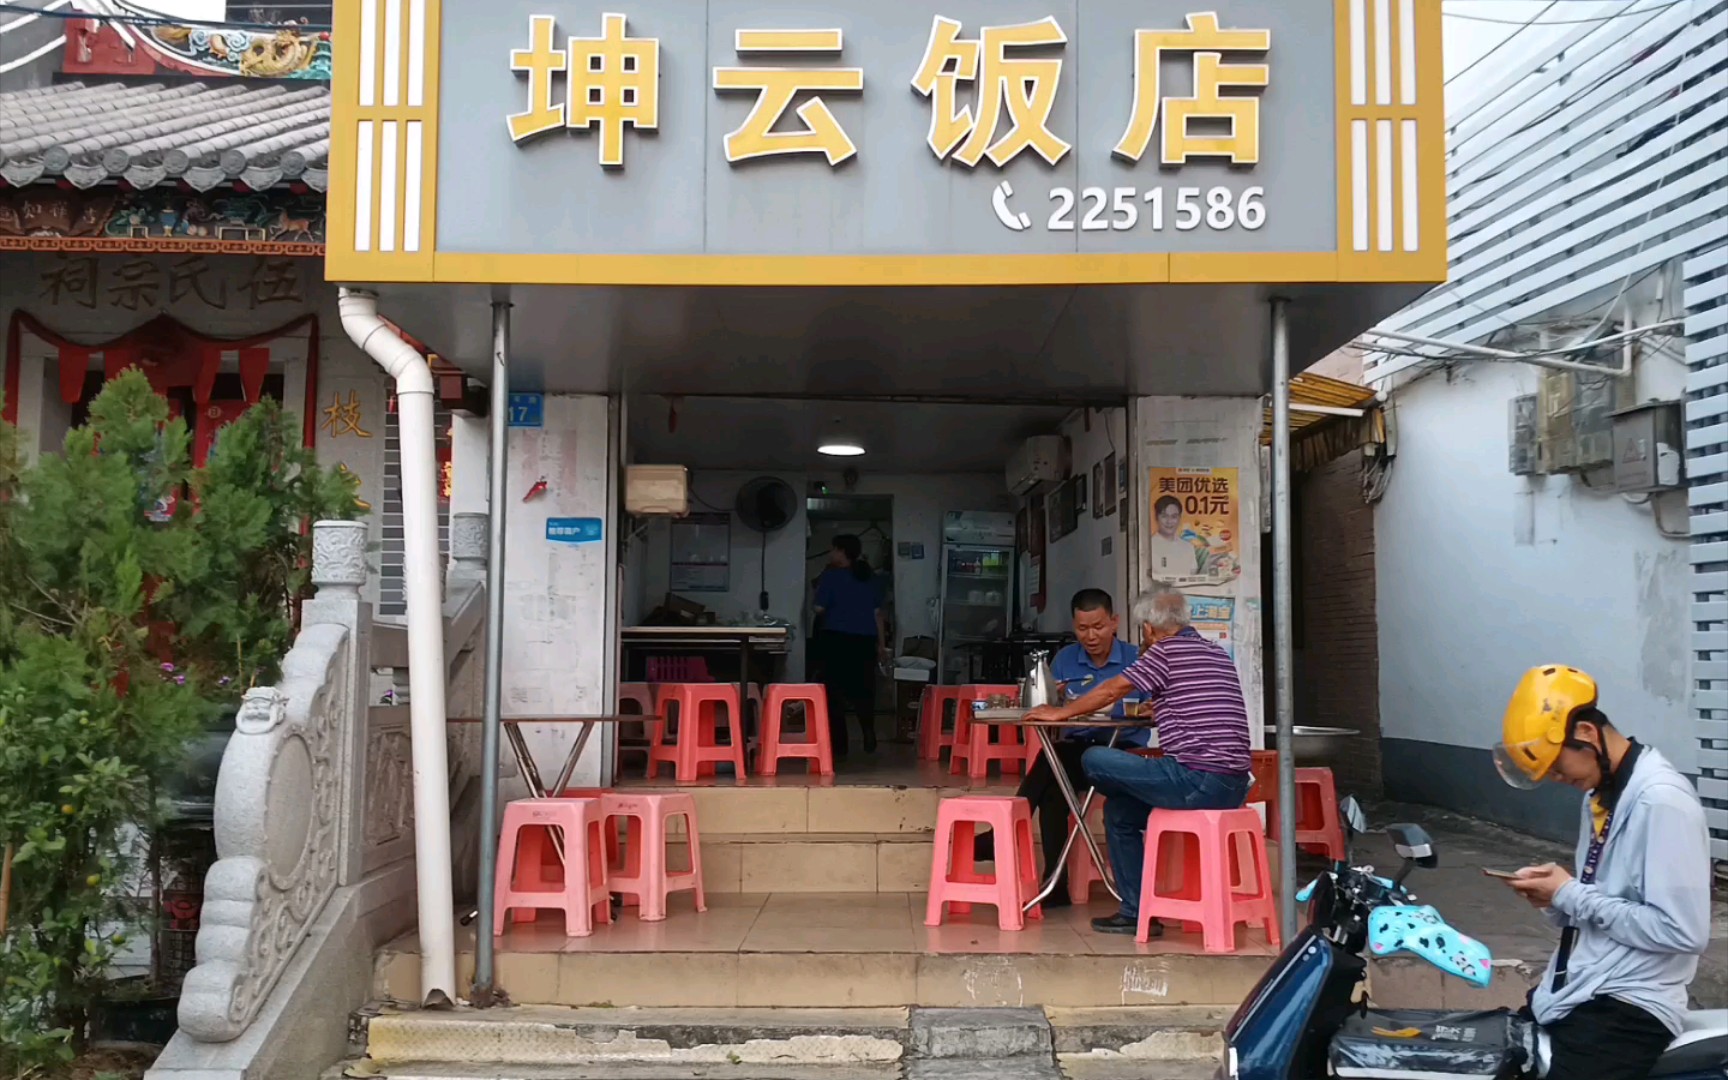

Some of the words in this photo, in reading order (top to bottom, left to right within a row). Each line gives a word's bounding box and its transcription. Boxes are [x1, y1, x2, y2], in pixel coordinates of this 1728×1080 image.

[507, 11, 1271, 169] 坤云饭店
[1046, 185, 1267, 231] 2251586
[1159, 477, 1229, 494] 美团优选
[1185, 495, 1229, 515] 0.1元
